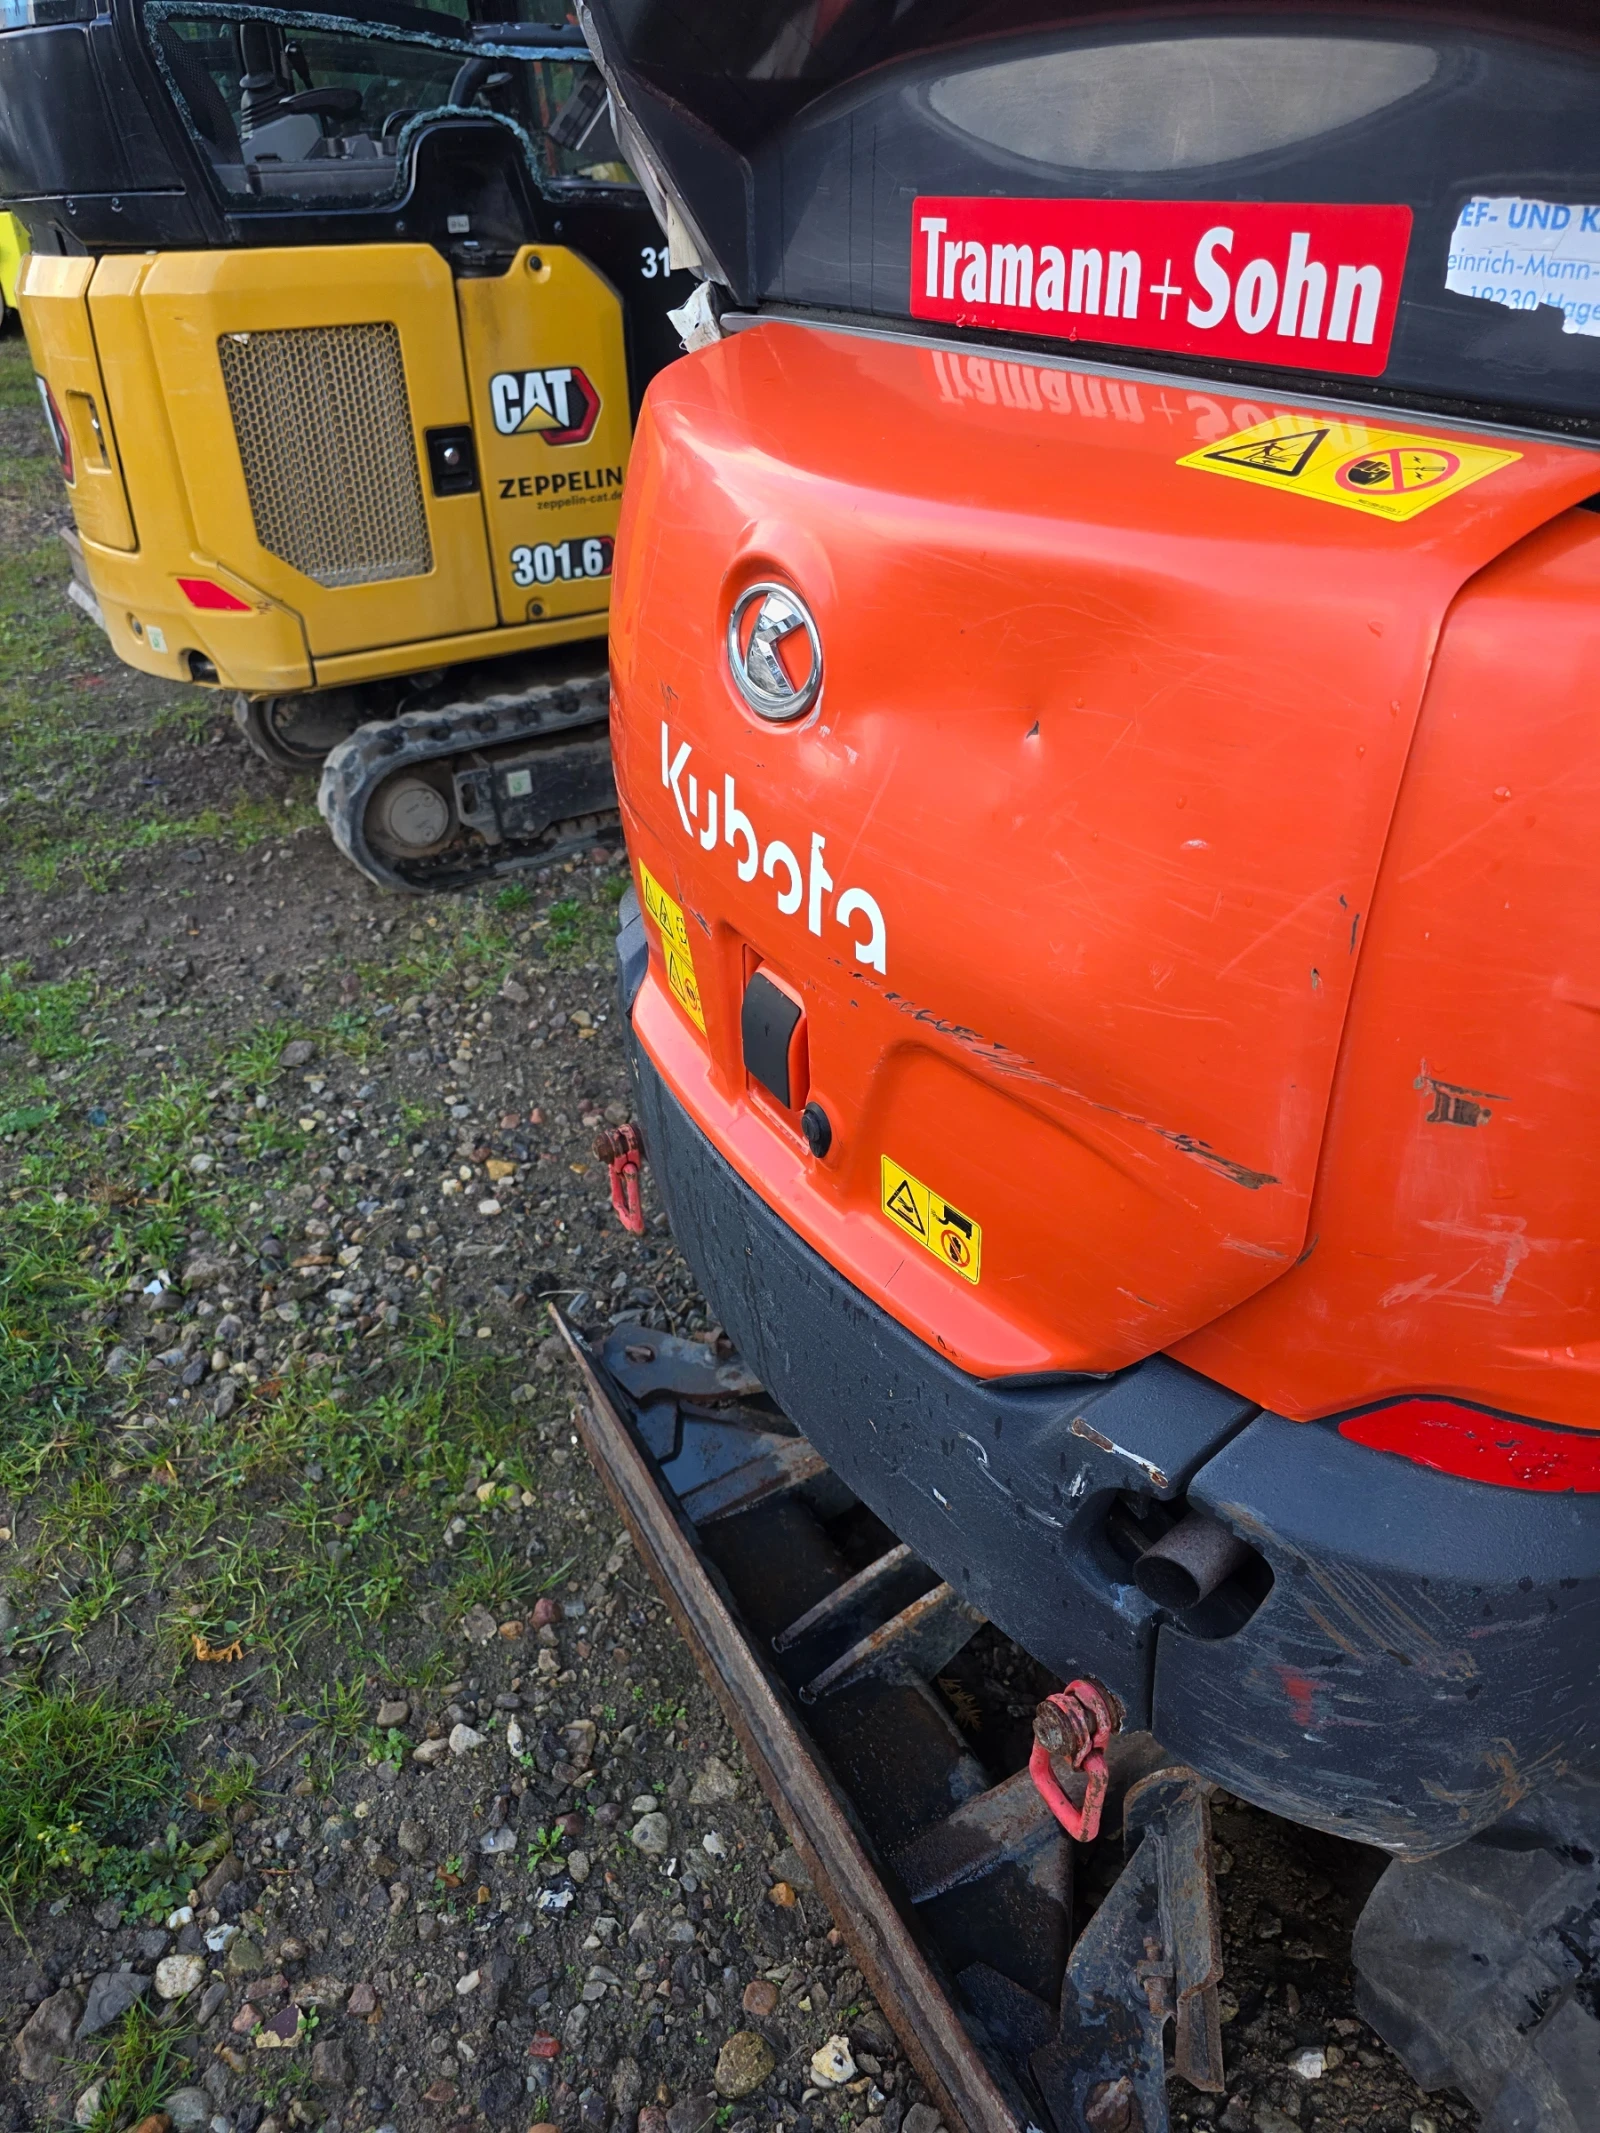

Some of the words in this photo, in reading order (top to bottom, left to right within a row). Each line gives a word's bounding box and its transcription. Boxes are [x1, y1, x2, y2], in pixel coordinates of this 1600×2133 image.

[1508, 203, 1571, 231] UND
[1580, 206, 1600, 233] K
[641, 246, 671, 278] 31
[490, 368, 572, 435] CAT
[498, 466, 623, 499] ZEPPELIN
[511, 538, 604, 586] 301.6
[661, 720, 887, 975] Kubota
